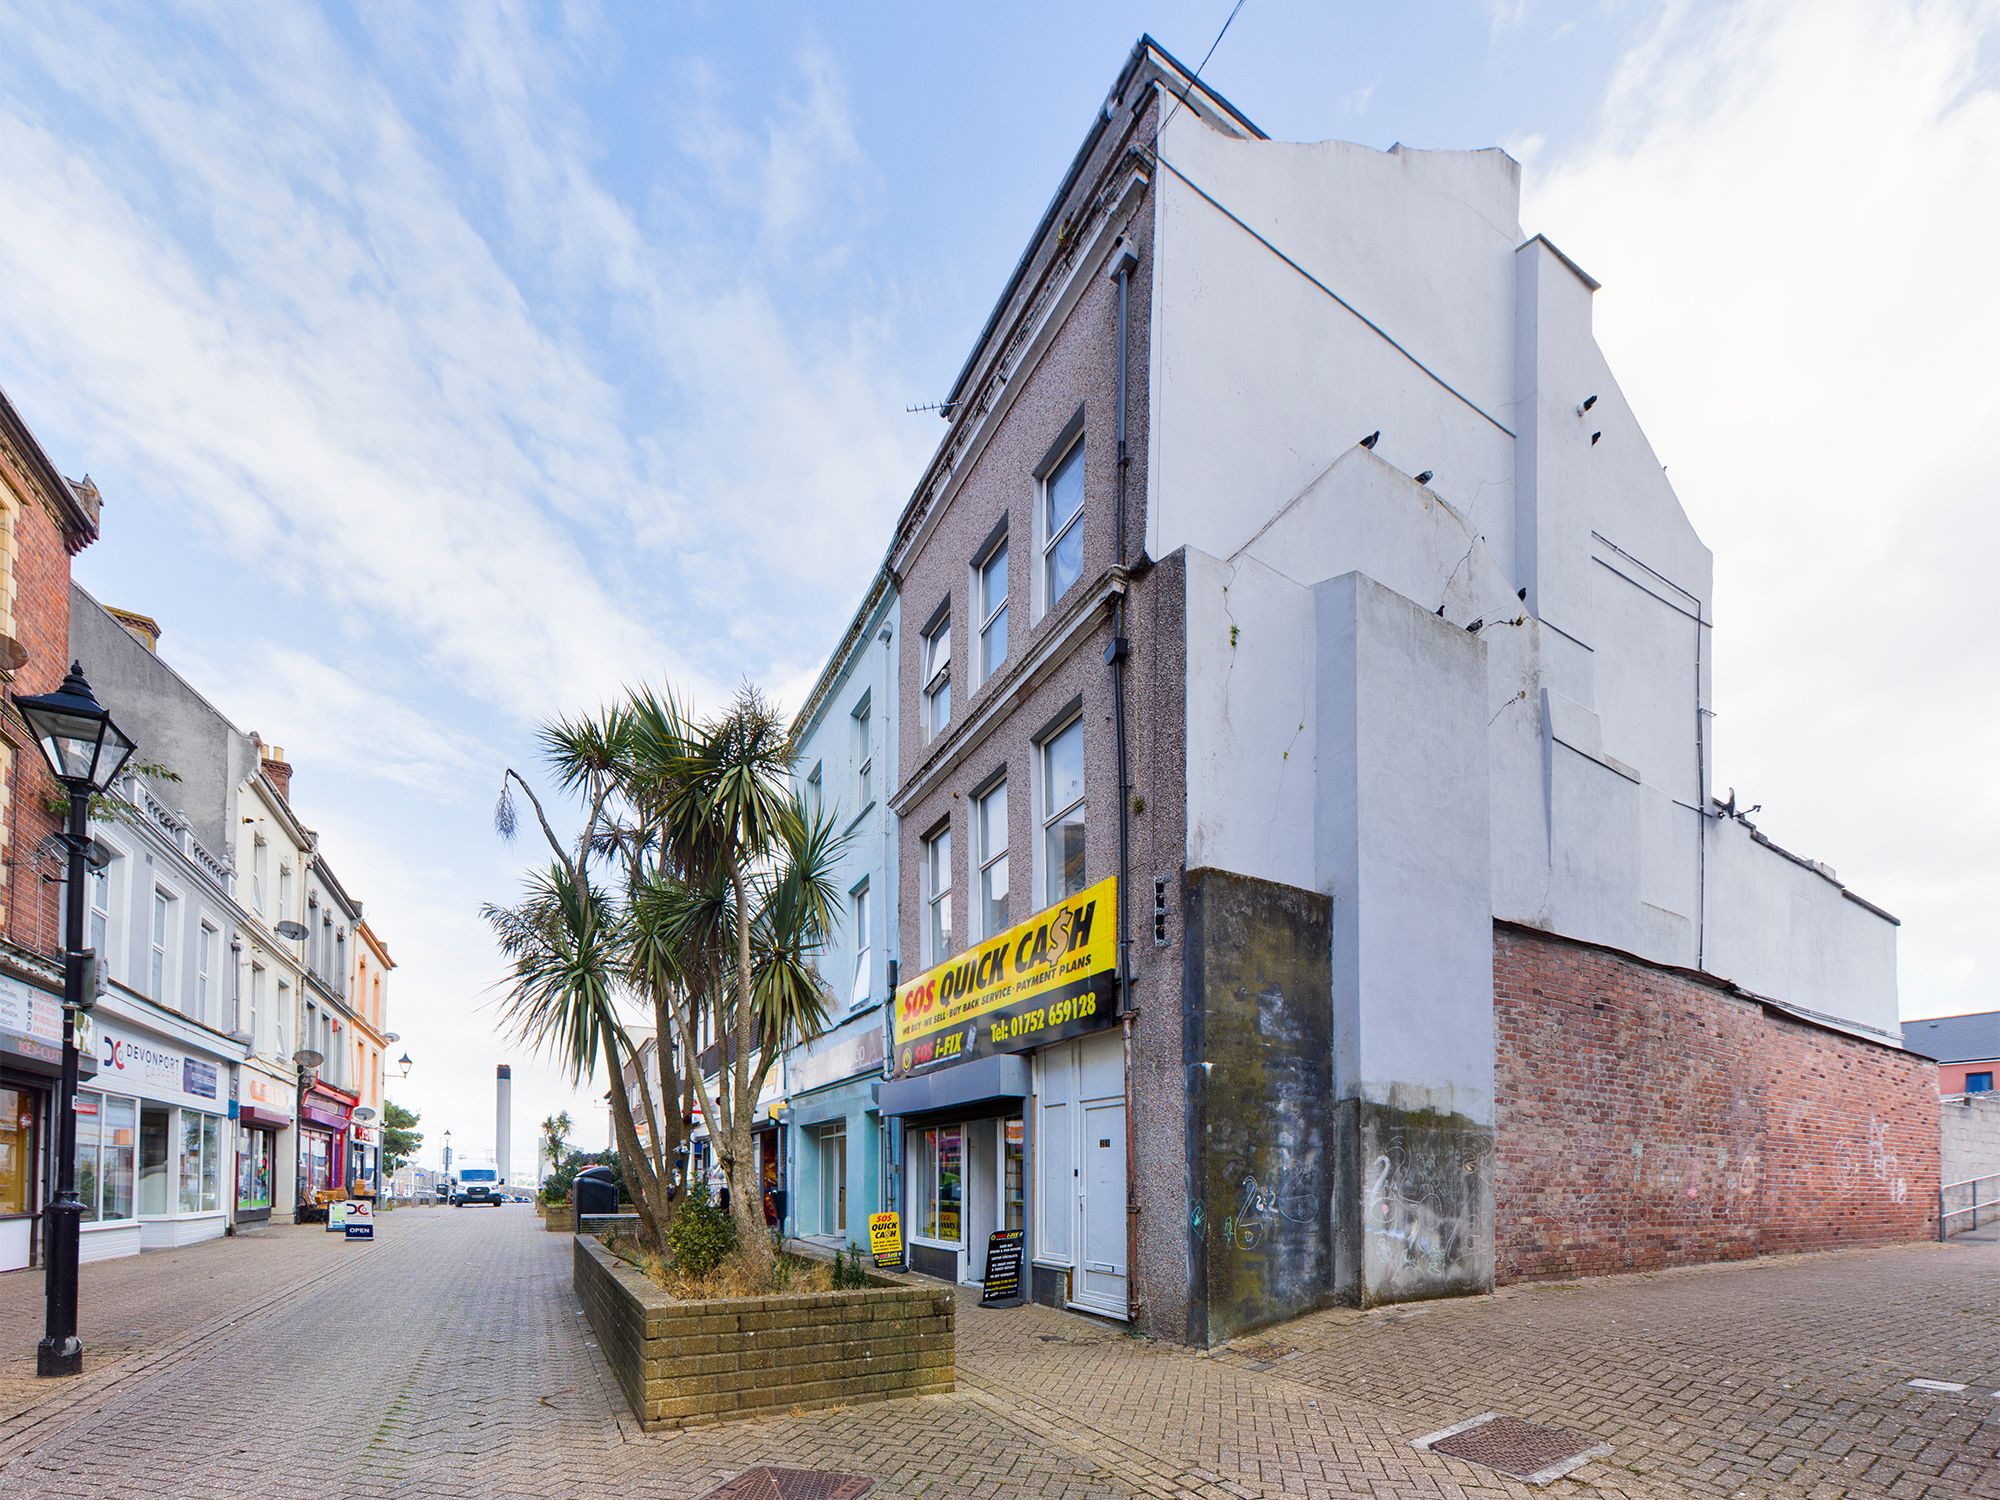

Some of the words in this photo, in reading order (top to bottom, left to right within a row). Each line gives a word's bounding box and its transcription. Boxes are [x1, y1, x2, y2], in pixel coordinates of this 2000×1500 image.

[903, 979, 935, 1021] SOS
[940, 943, 1010, 1008] QUICK
[903, 1026, 910, 1035] WE
[911, 1021, 921, 1032] BUY
[924, 1017, 932, 1027] WE
[933, 1012, 945, 1025] SELL
[949, 1005, 961, 1018] BUY
[963, 998, 980, 1012] BACK
[981, 985, 1012, 1005] SERVICE
[1016, 968, 1057, 992] PAYMENT
[1059, 954, 1091, 976] PLANS
[991, 1019, 1008, 1042] Tel:
[1010, 1008, 1045, 1037] 01752
[1048, 992, 1096, 1026] 659128
[127, 1044, 179, 1071] DEVONPORT
[913, 1041, 934, 1064] SOS
[935, 1032, 963, 1058] i-FIX
[871, 1222, 897, 1231] QUICK
